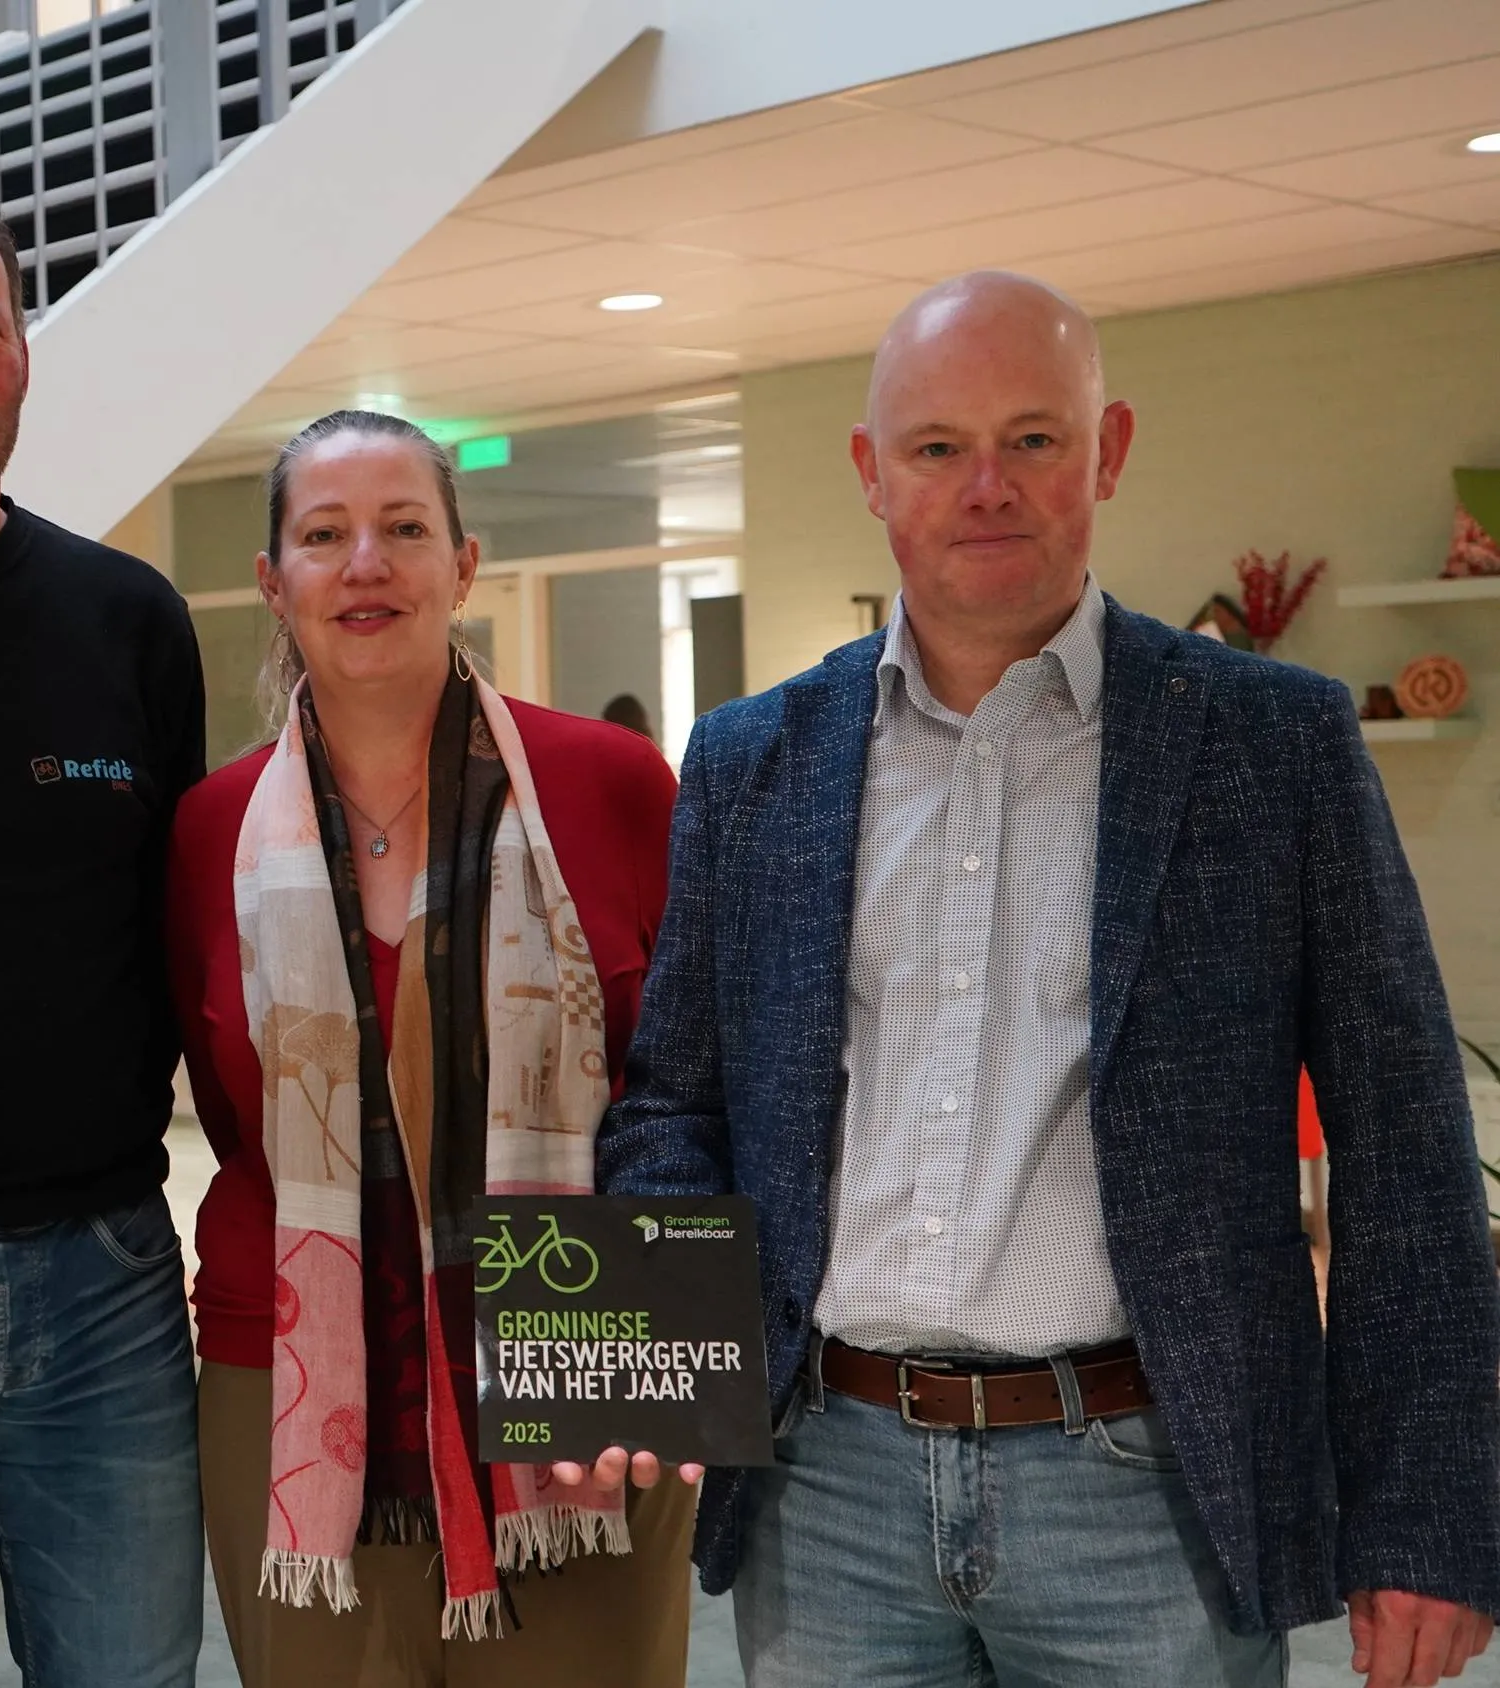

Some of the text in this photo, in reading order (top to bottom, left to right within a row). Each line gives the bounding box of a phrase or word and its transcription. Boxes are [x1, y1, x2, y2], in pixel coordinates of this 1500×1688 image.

[664, 1215, 730, 1228] Groningen
[665, 1228, 735, 1239] Bereikbaar
[498, 1311, 650, 1340] GRONINGSE
[500, 1341, 741, 1371] FIETSWERKGEVER
[499, 1370, 695, 1401] VAN HET JAAR
[502, 1422, 551, 1444] 2025
